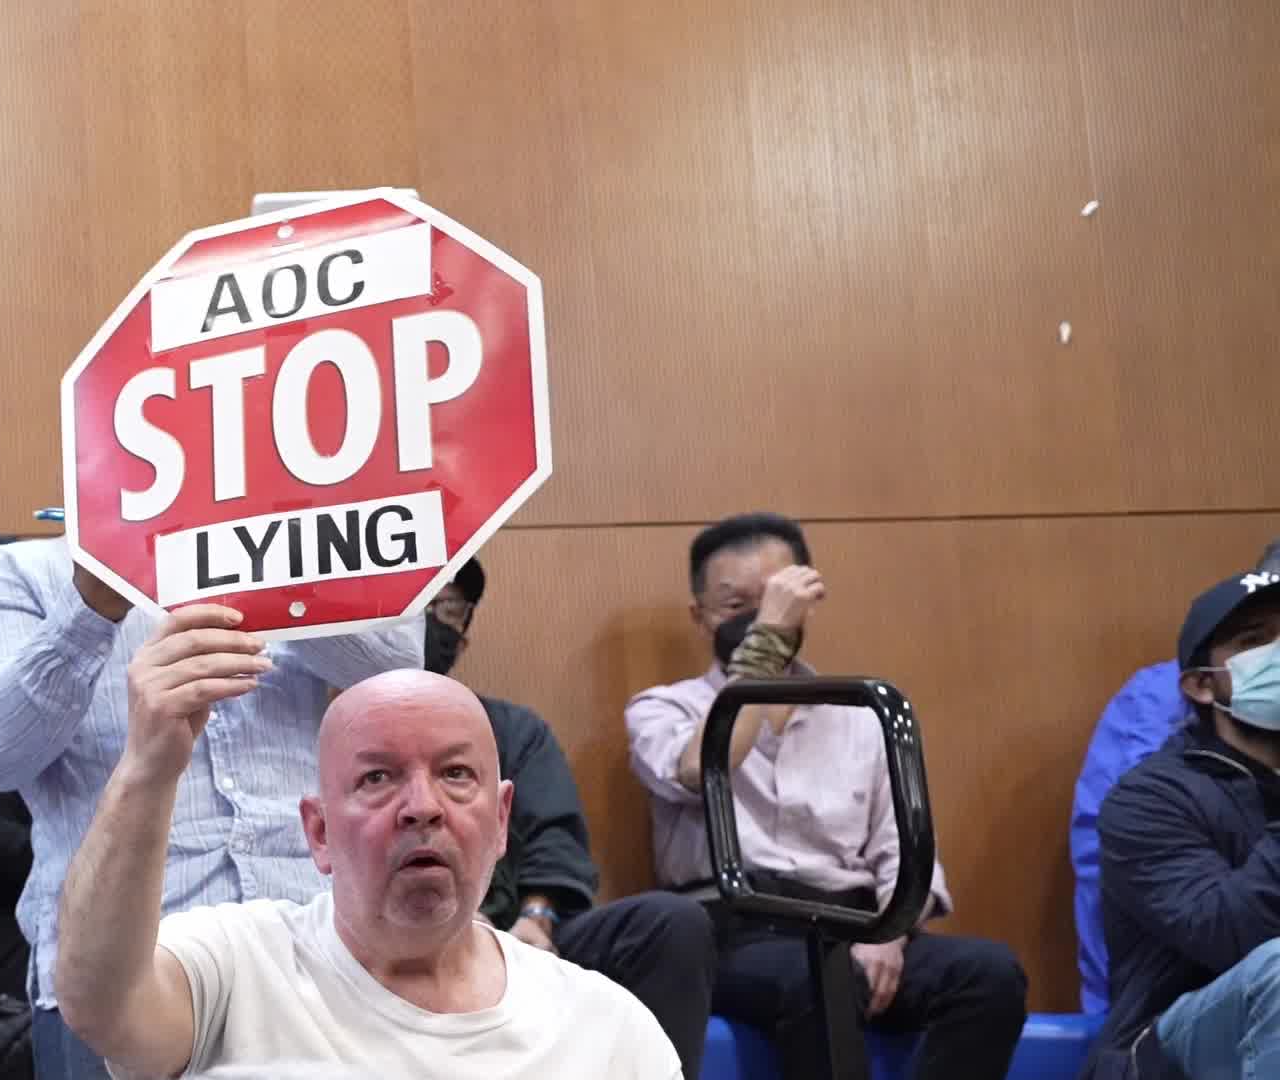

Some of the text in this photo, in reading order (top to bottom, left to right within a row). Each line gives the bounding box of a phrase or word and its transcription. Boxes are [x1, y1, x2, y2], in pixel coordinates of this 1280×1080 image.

[200, 248, 366, 333] AOC
[112, 309, 483, 522] STOP
[195, 504, 419, 590] LYING
